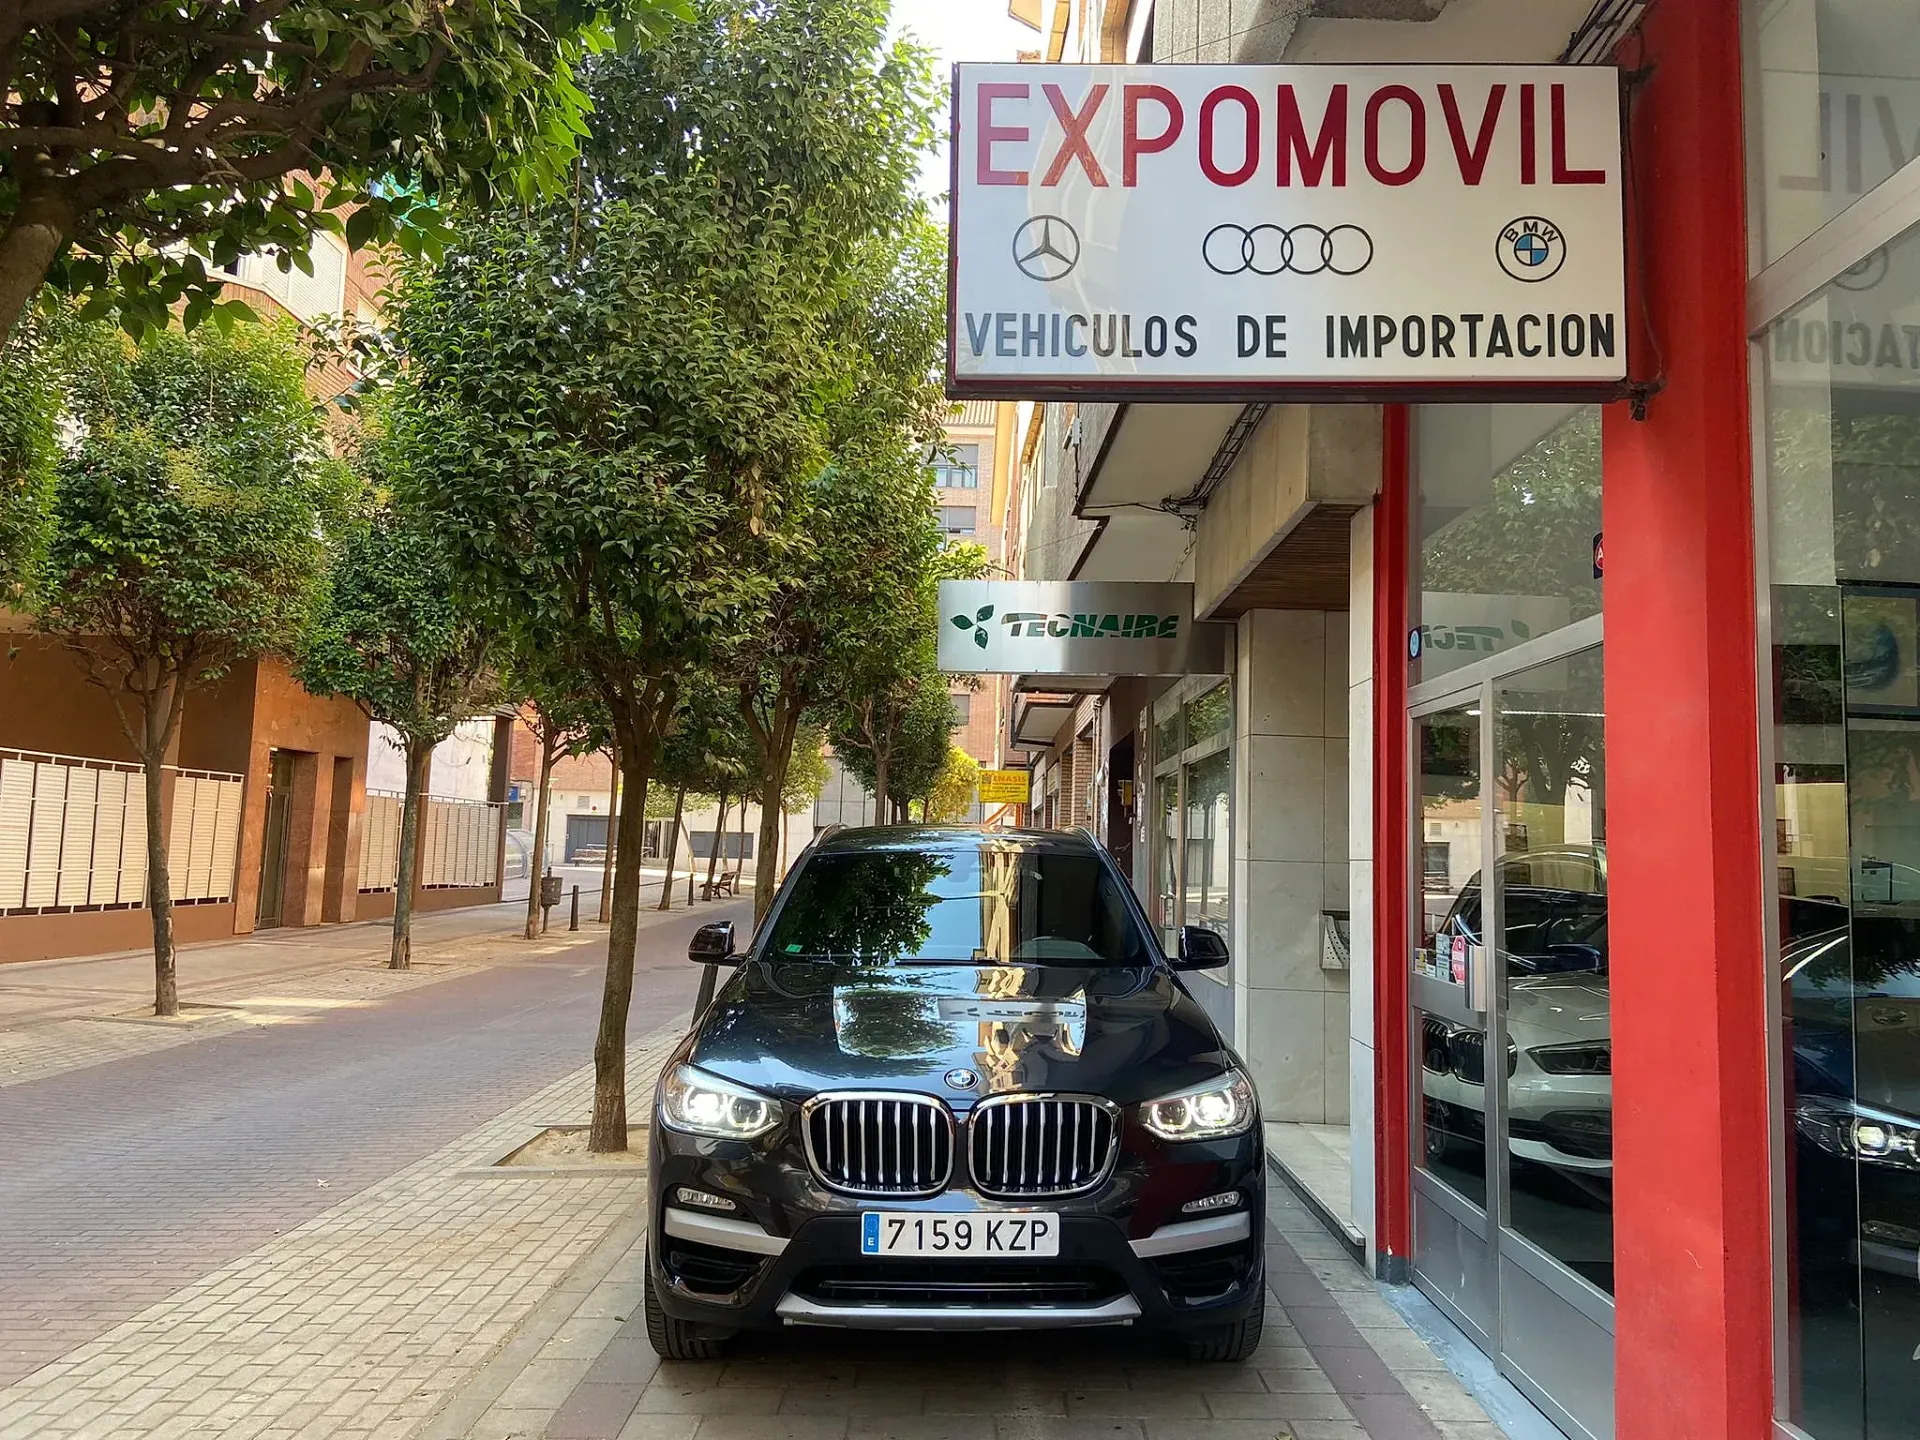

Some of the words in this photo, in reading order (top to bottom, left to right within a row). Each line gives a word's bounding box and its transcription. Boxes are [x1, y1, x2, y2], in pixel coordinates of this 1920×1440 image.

[977, 84, 1606, 188] EXPOMOVIL
[1503, 220, 1559, 243] BMW
[964, 311, 1198, 358] VEHICULOS
[1236, 314, 1287, 358] DE
[1325, 313, 1615, 358] IMPORTACION
[1001, 612, 1179, 638] TECNAIRE
[867, 1237, 875, 1246] E
[887, 1219, 973, 1251] 7159
[986, 1219, 1049, 1251] KZP
